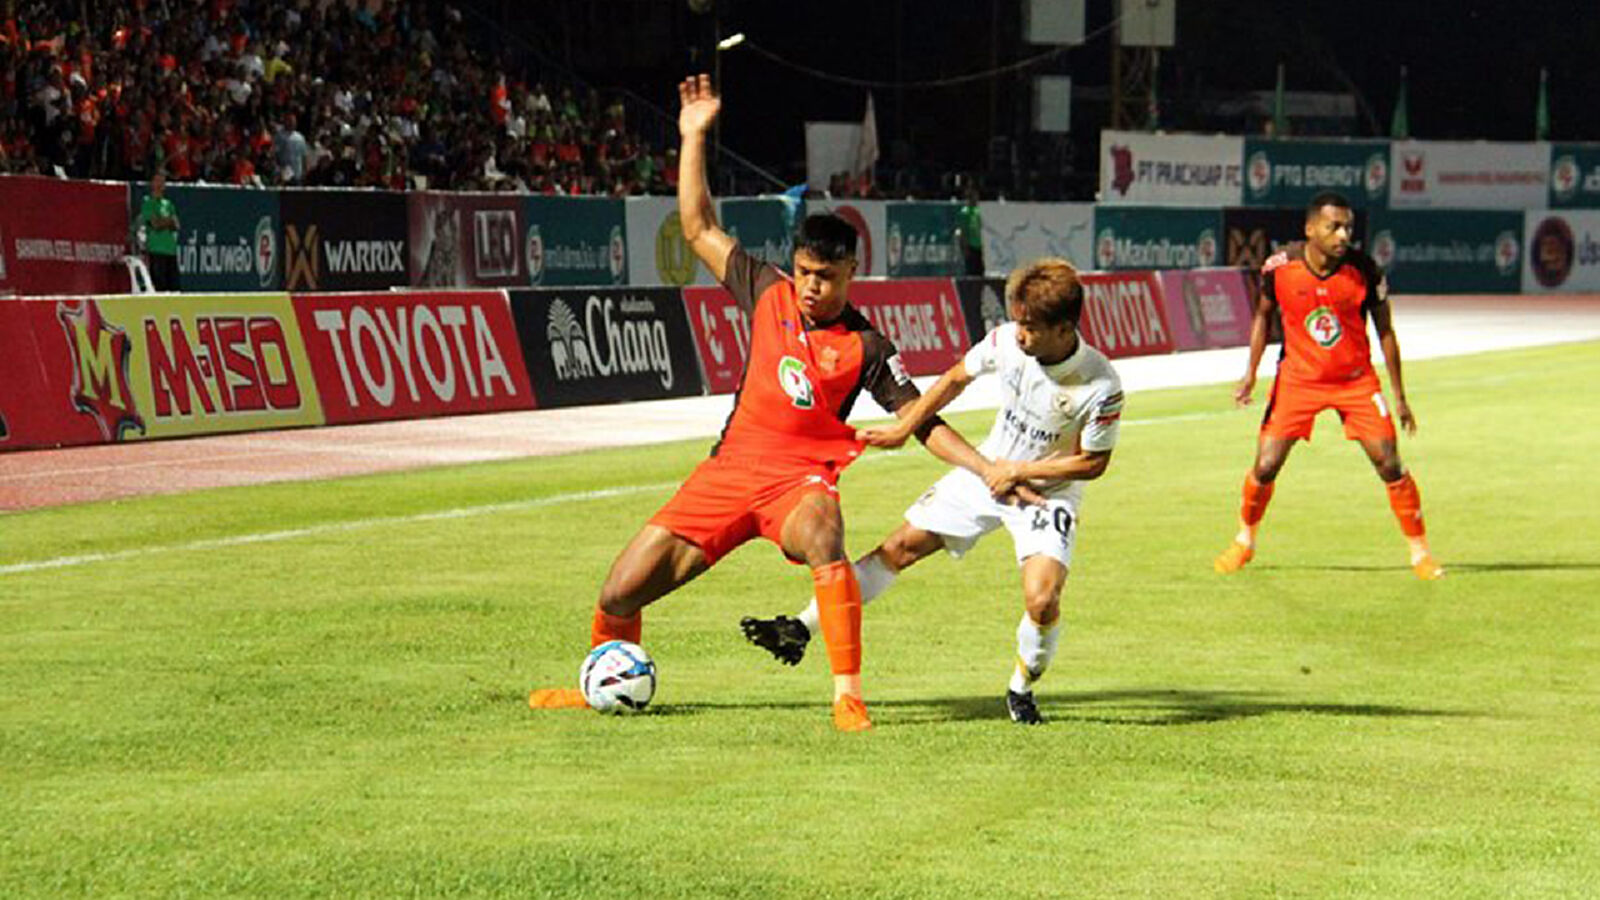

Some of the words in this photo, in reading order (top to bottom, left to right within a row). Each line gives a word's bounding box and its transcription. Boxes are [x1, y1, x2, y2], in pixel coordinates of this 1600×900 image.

[325, 240, 405, 272] WARRIX
[478, 210, 515, 274] LEO
[585, 295, 673, 390] Chang
[874, 302, 943, 352] LEAGUE
[1083, 280, 1168, 351] TOYOTA
[314, 304, 518, 408] TOYOTA
